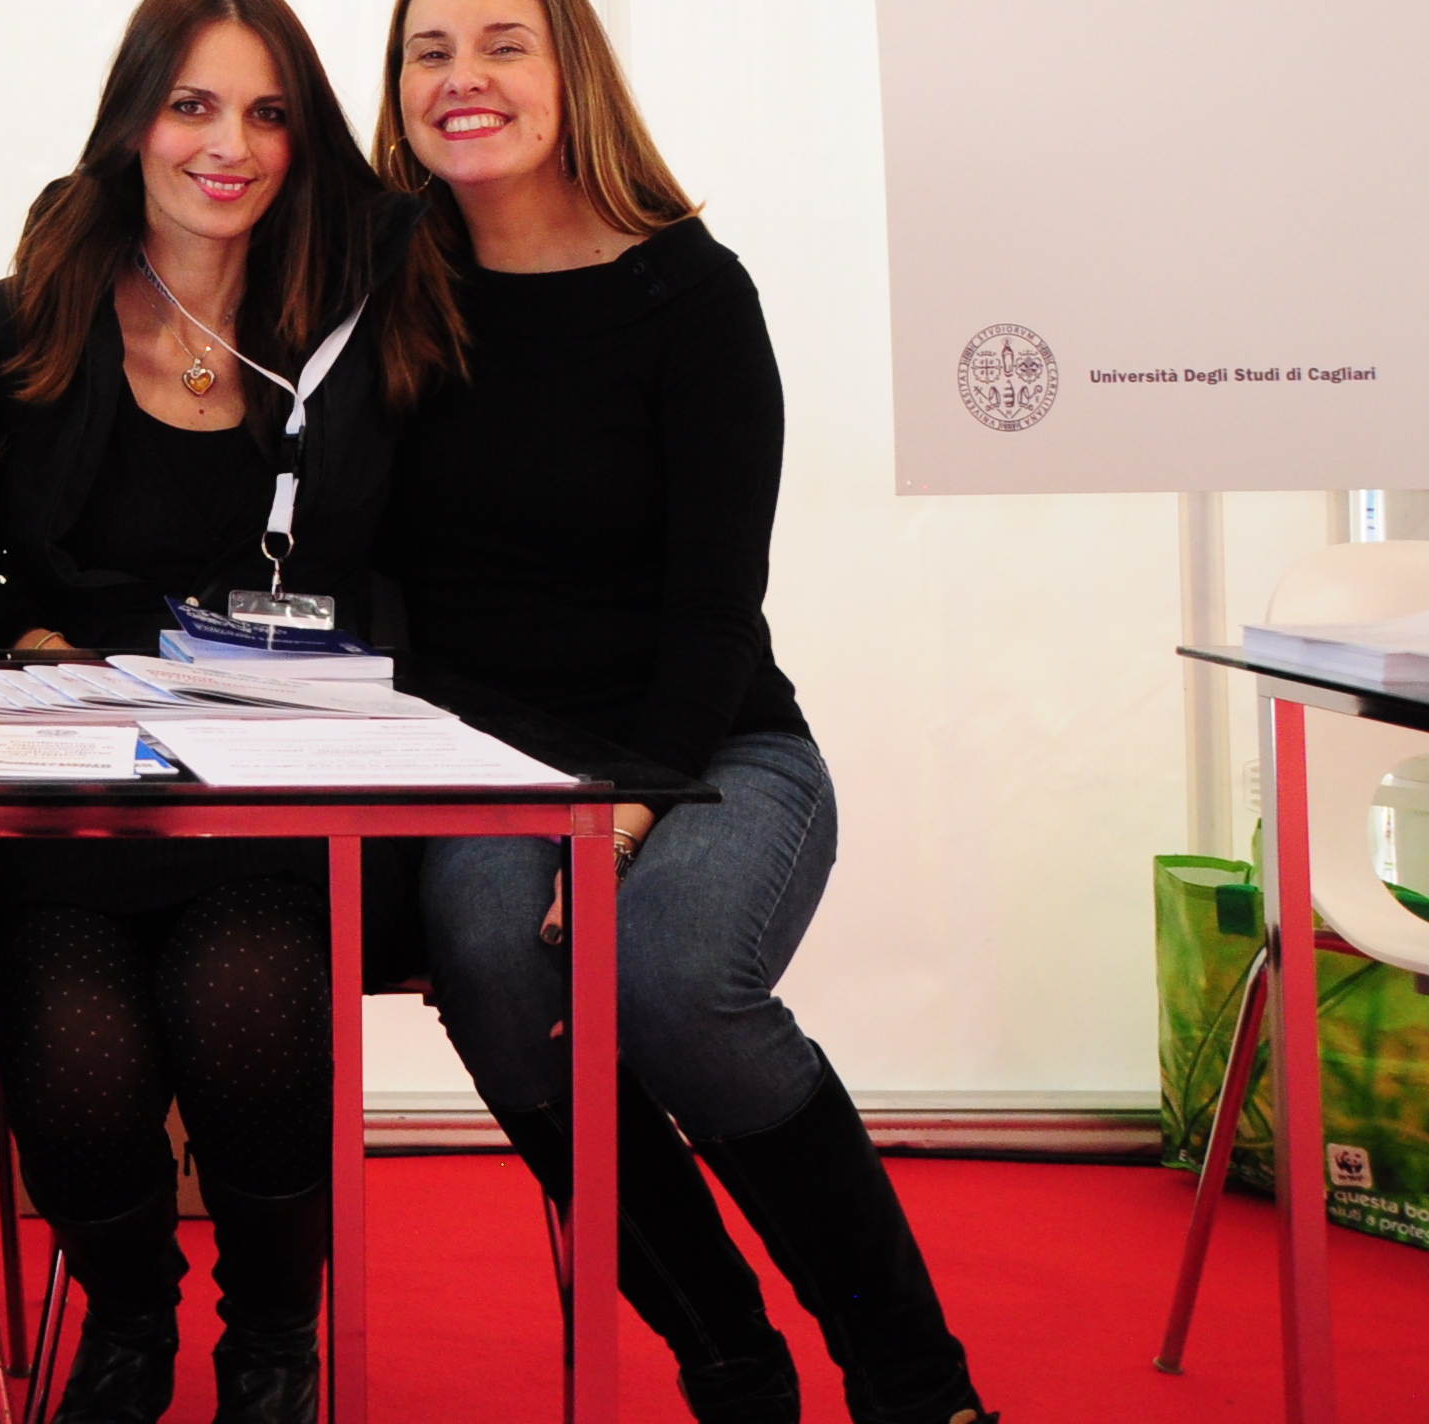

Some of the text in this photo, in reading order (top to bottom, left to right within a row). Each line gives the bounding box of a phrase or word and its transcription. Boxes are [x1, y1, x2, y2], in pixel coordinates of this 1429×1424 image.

[1090, 366, 1376, 385] Università Degli Studi di Cagliari
[1334, 1191, 1399, 1214] questa
